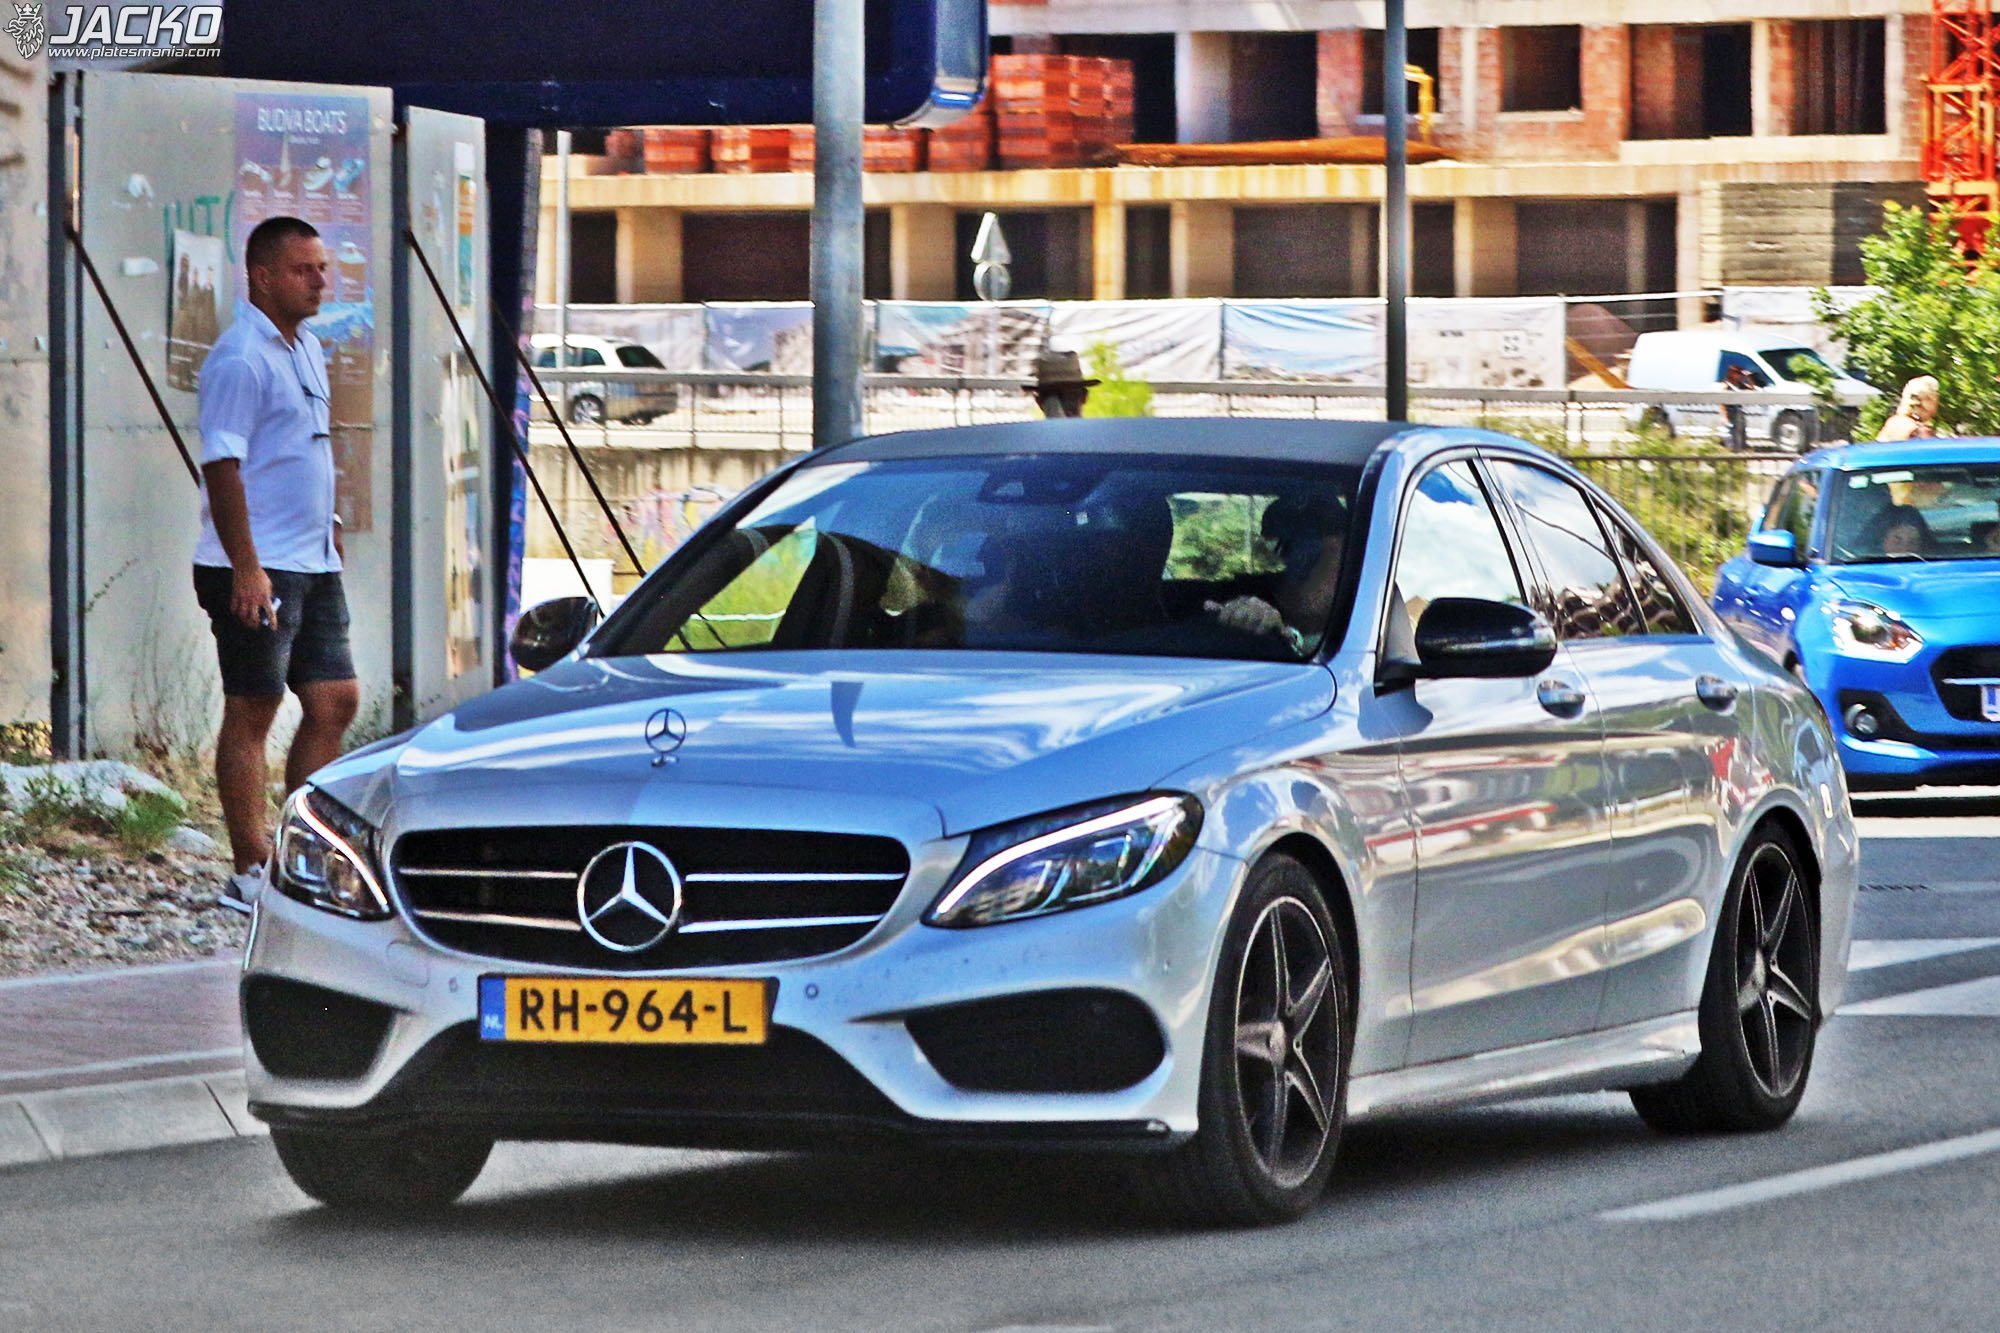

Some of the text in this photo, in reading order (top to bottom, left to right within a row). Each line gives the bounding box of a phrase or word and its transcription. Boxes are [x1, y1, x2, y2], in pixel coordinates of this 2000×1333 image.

[257, 107, 347, 135] BUDVA BOATS
[484, 1013, 503, 1030] NL
[519, 987, 748, 1033] RH-964-L
